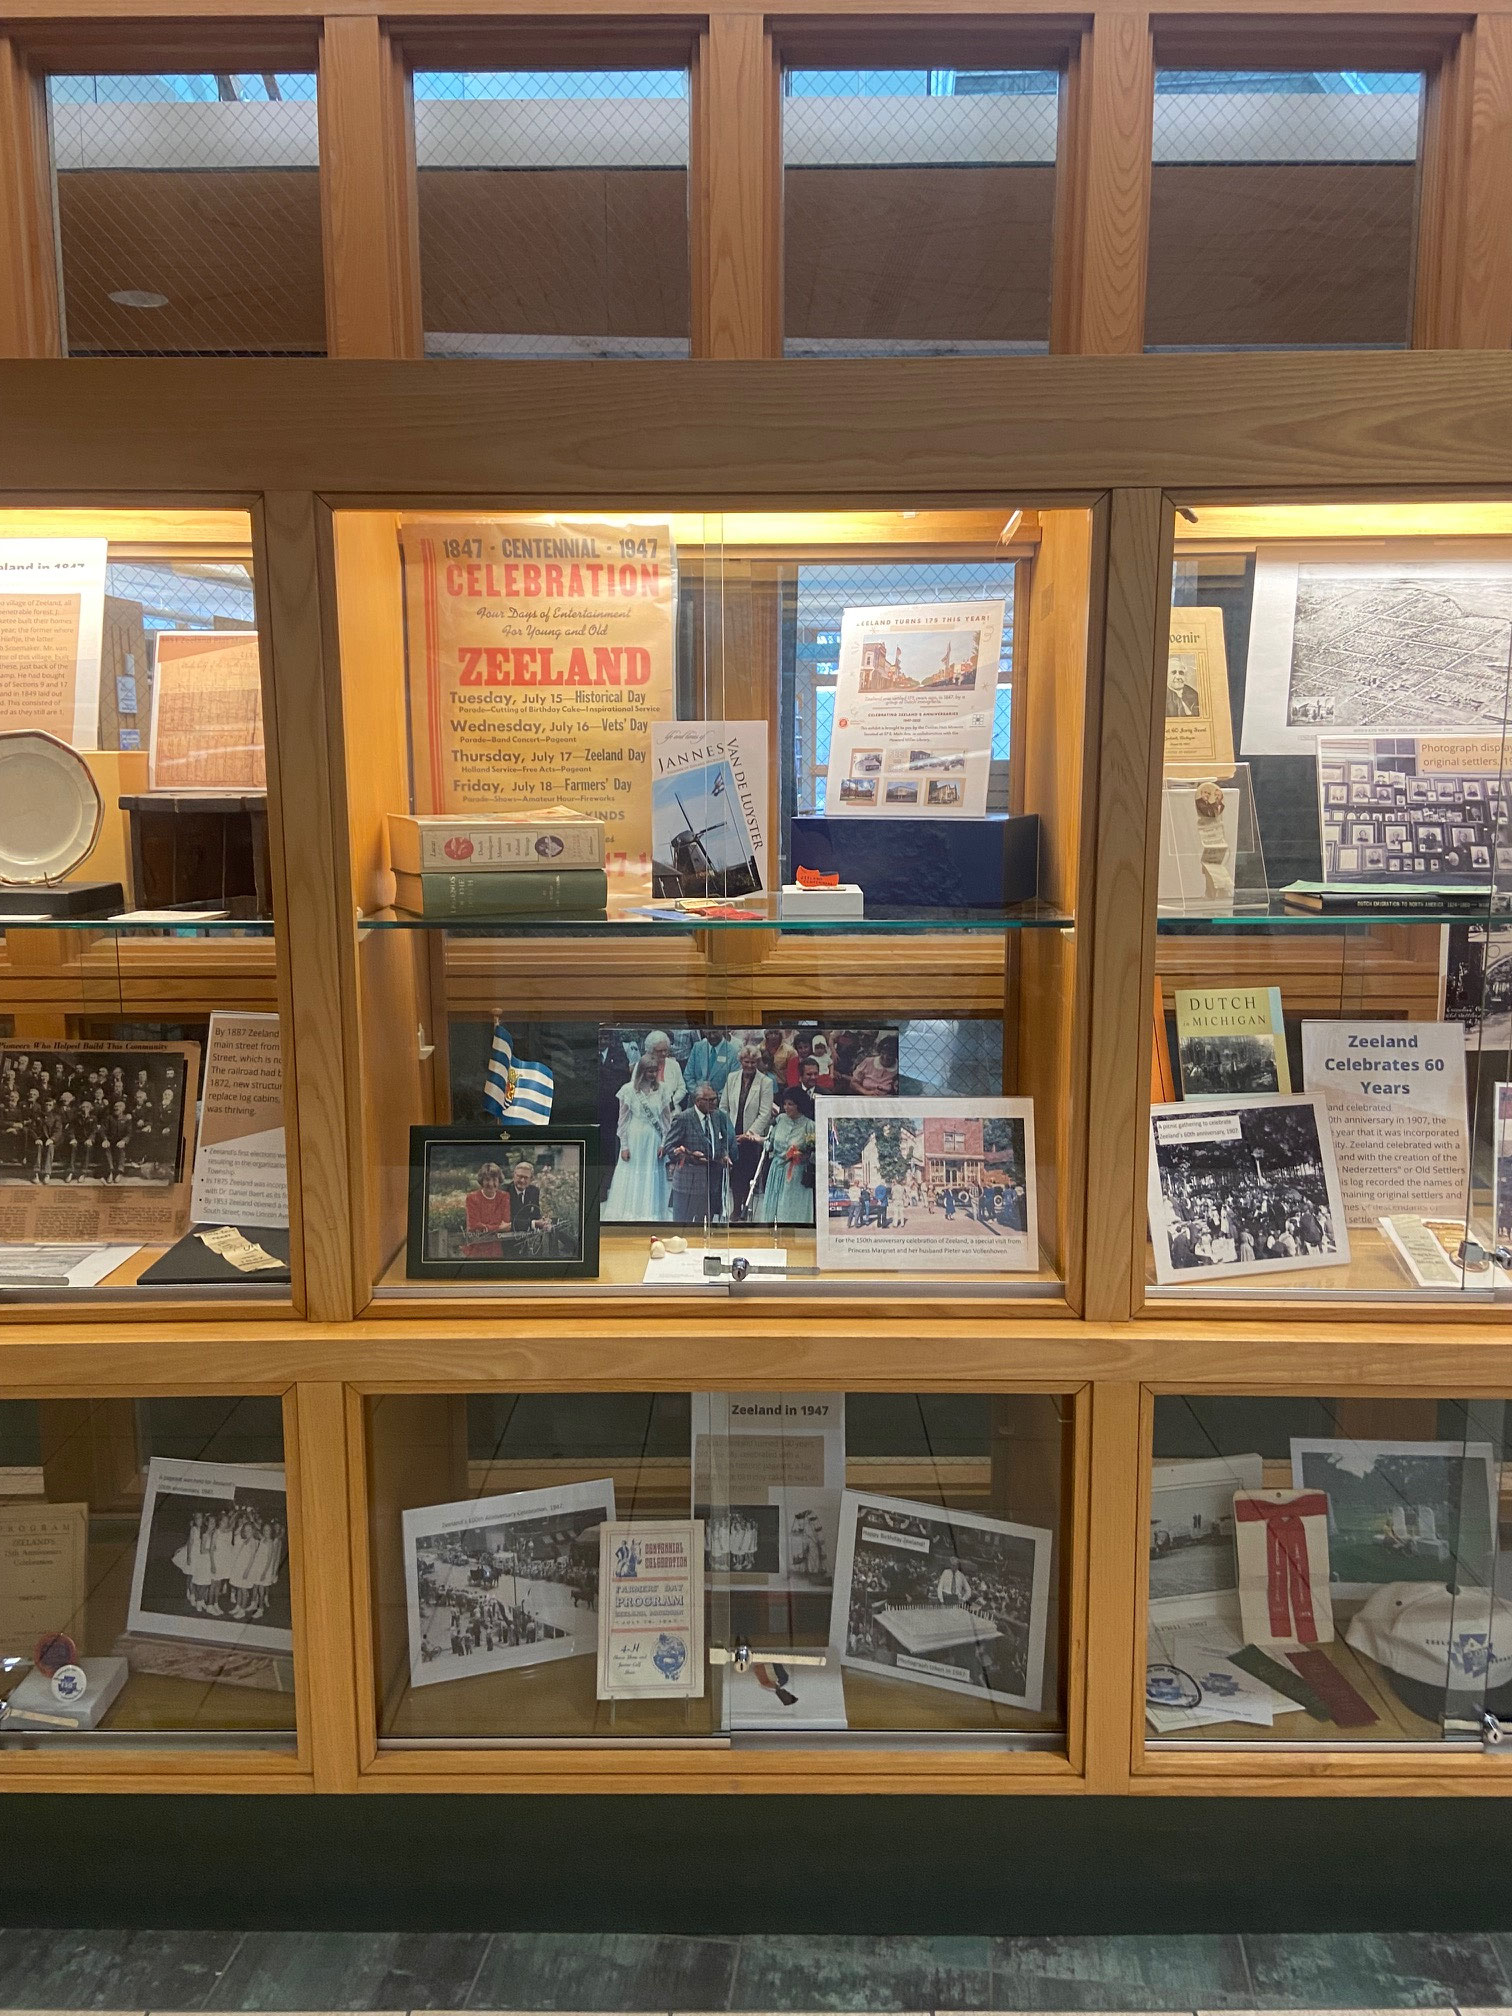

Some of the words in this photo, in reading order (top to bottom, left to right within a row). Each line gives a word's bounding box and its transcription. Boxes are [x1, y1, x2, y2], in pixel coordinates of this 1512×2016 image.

[443, 539, 482, 558] 1847
[502, 539, 600, 558] CENTENNIAL
[620, 539, 658, 558] 1947
[447, 564, 659, 597] CELEBRATION
[477, 607, 505, 619] Four
[508, 607, 537, 621] Days
[540, 607, 550, 622] of
[553, 607, 631, 618] Entertainment
[502, 625, 523, 636] For
[526, 625, 560, 639] Young
[565, 624, 585, 636] and
[589, 624, 608, 636] Old
[458, 647, 652, 686] ZEELAND
[450, 691, 517, 705] Tuesday,
[522, 694, 546, 705] July
[628, 691, 646, 705] Day
[450, 719, 546, 733] Wednesday,
[550, 721, 573, 733] July
[630, 719, 648, 733] Day
[451, 750, 525, 763] Thursday,
[531, 752, 554, 763] July
[628, 749, 646, 763] Day
[727, 736, 743, 768] VAN
[1422, 744, 1478, 754] Photograph
[1481, 744, 1512, 756] dispay
[659, 743, 724, 773] JANNES
[1424, 758, 1459, 768] original
[1462, 758, 1500, 766] settlers,
[453, 780, 504, 793] Friday,
[512, 782, 535, 793] July
[614, 778, 632, 792] Day
[734, 772, 748, 789] DE
[740, 793, 764, 850] LUYSTER
[1190, 997, 1256, 1010] DUTCH
[1193, 1015, 1266, 1026] MICHIGAN
[215, 1028, 225, 1036] By
[228, 1028, 246, 1036] 1887
[248, 1029, 279, 1037] Zeeland
[54, 1042, 80, 1050] Helped
[83, 1042, 104, 1050] Build
[214, 1041, 233, 1049] main
[235, 1042, 259, 1050] street
[260, 1042, 280, 1050] from
[1348, 1035, 1418, 1048] Zeeland
[240, 1055, 263, 1063] which
[1325, 1058, 1419, 1071] Celebrates
[1424, 1059, 1444, 1071] 60
[211, 1066, 226, 1074] The
[228, 1067, 259, 1075] railroad
[260, 1068, 276, 1076] had
[211, 1079, 230, 1088] 1872,
[1360, 1082, 1410, 1094] Years
[209, 1093, 237, 1101] replace
[240, 1093, 251, 1103] log
[1346, 1104, 1392, 1112] celebrated
[1179, 1121, 1202, 1129] gathering
[1344, 1117, 1394, 1127] anniversary
[1407, 1117, 1430, 1125] 1907,
[1336, 1130, 1354, 1138] year
[1403, 1129, 1459, 1138] incorporated
[1350, 1141, 1384, 1149] Zeeland
[1386, 1141, 1432, 1149] celebrated
[1415, 1166, 1430, 1174] Old
[1433, 1166, 1465, 1174] Settlers
[1350, 1178, 1363, 1187] log
[1377, 1191, 1409, 1200] original
[1411, 1191, 1443, 1199] settlers
[732, 1405, 781, 1415] Zeeland
[786, 1405, 797, 1415] in
[801, 1406, 828, 1415] 1947
[616, 1595, 683, 1608] PROGRAM
